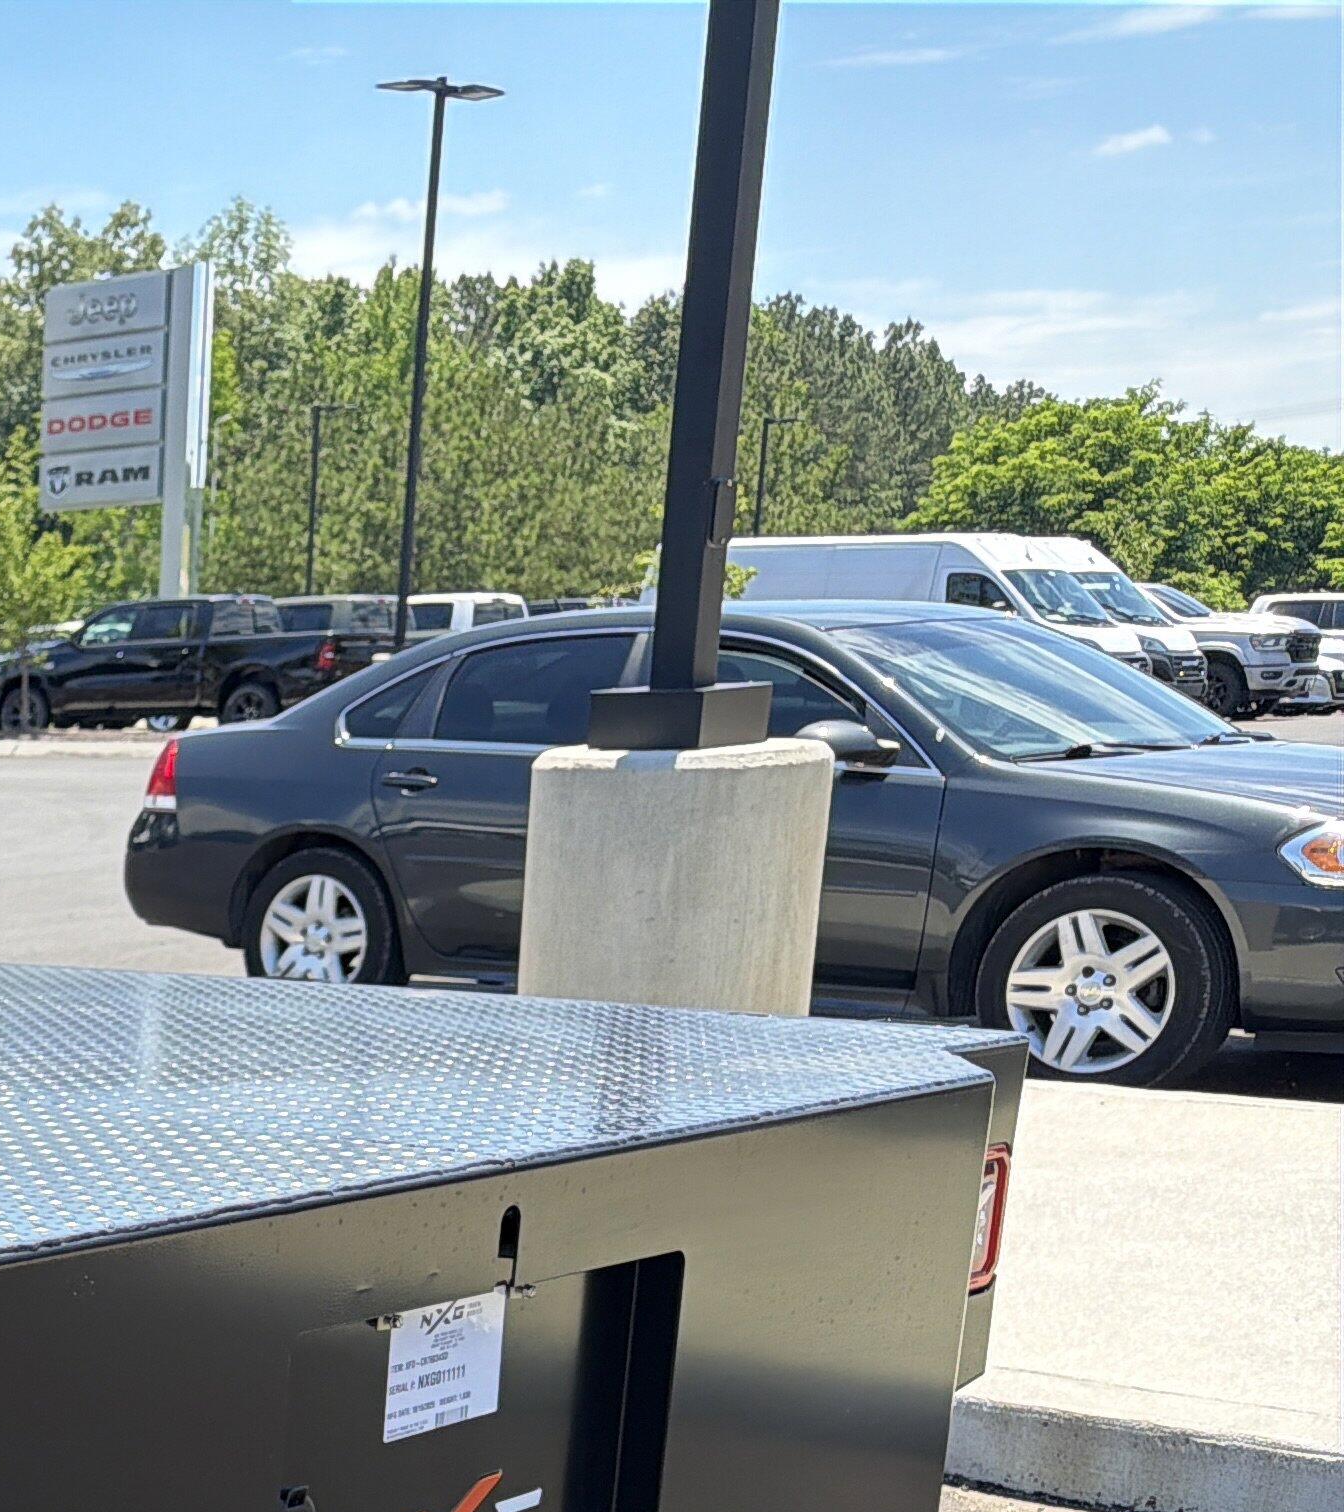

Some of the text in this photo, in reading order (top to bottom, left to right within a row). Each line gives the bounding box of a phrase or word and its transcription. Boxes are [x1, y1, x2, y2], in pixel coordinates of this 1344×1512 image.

[68, 291, 138, 326] Jeep
[51, 344, 152, 368] CHRYSLER
[47, 408, 153, 435] DODGE
[74, 465, 151, 487] RAM
[420, 1300, 465, 1336] NXG
